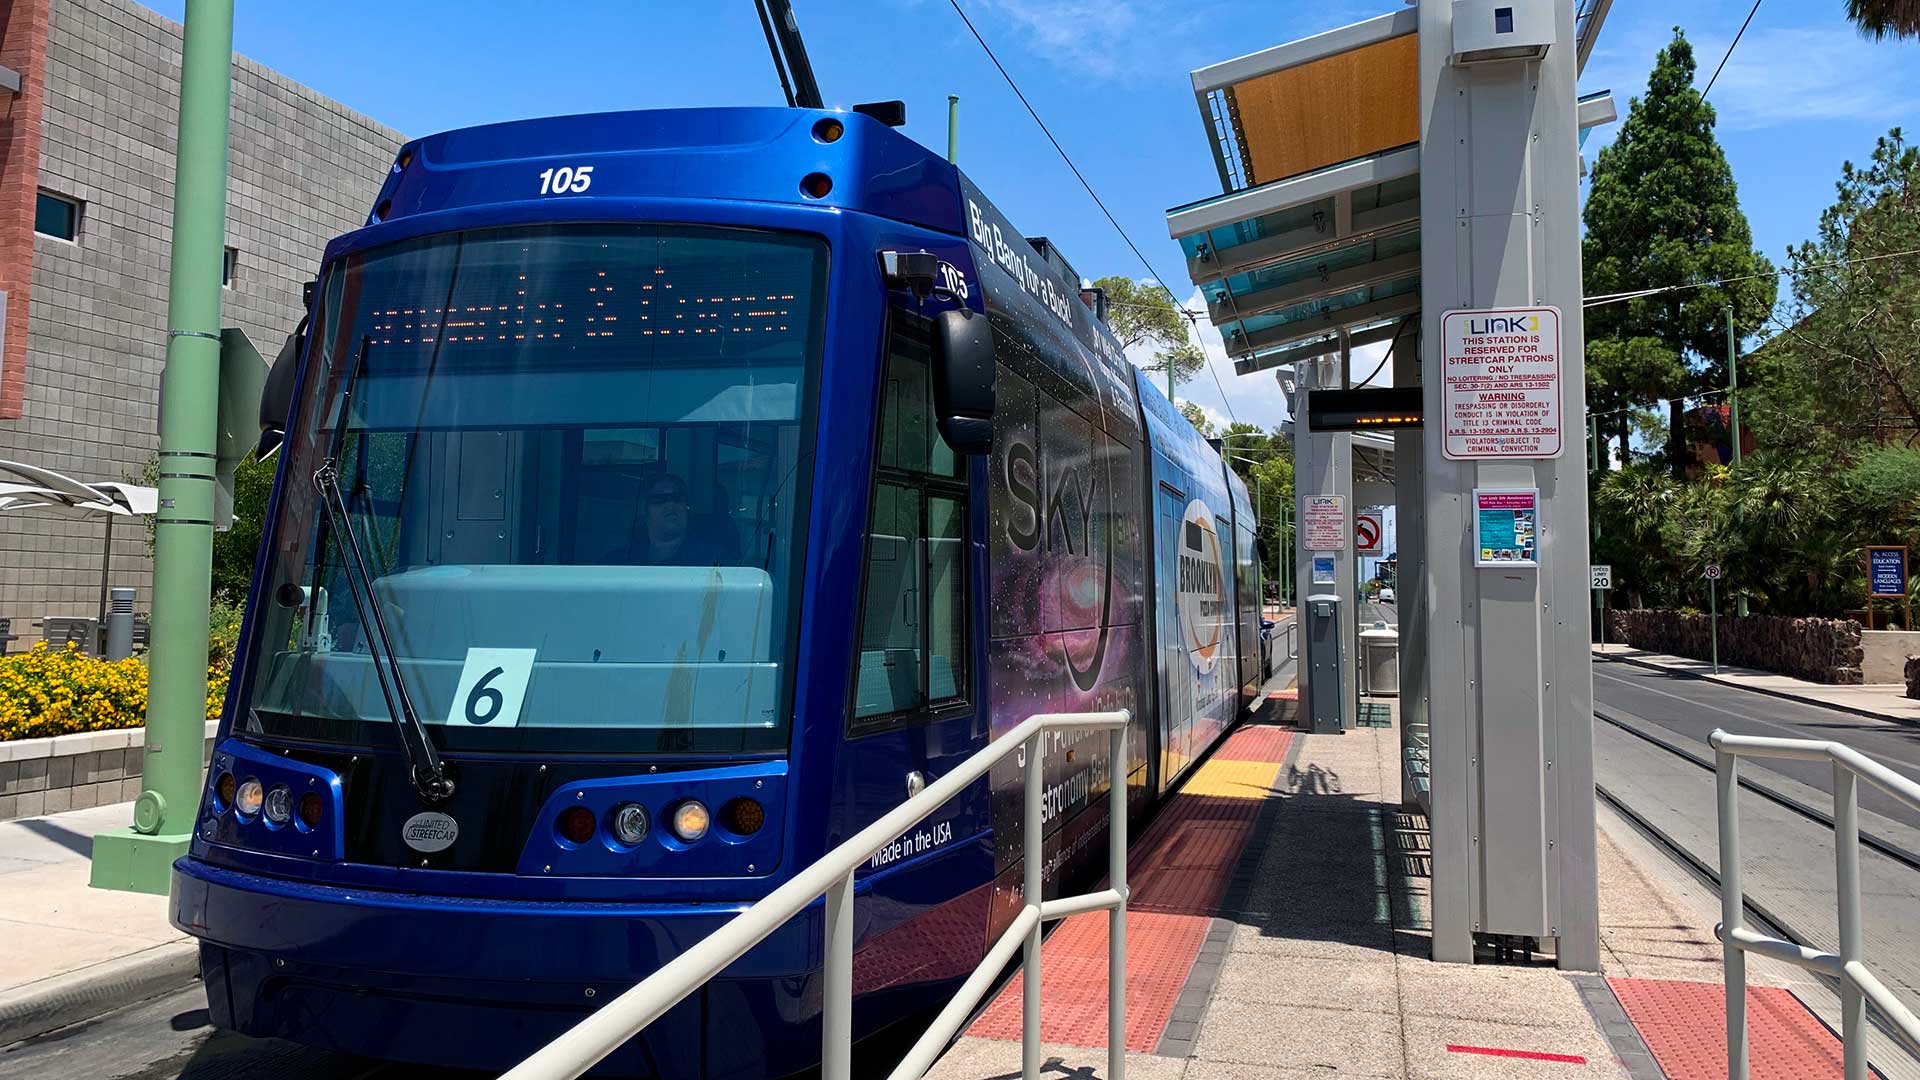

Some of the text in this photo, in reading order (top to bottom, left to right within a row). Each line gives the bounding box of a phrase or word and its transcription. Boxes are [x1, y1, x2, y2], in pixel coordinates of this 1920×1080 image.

[540, 167, 594, 194] 105
[969, 198, 996, 264] Big
[993, 222, 1026, 292] Bang
[1024, 254, 1040, 296] for
[1041, 281, 1049, 306] a
[941, 264, 968, 299] 105
[1463, 337, 1484, 345] THIS
[1487, 336, 1527, 344] STATION
[1465, 345, 1537, 355] RESERVED FOR
[1449, 355, 1553, 365] STREETCAR PATRONS
[1479, 392, 1525, 400] WARNING
[1006, 442, 1096, 557] SKY
[1180, 555, 1216, 594] BROOKLYN
[1594, 578, 1608, 587] 20
[465, 667, 504, 725] 6
[1042, 766, 1088, 825] stronomy
[411, 828, 455, 840] STREETCAR
[872, 821, 952, 868] Made in the USA
